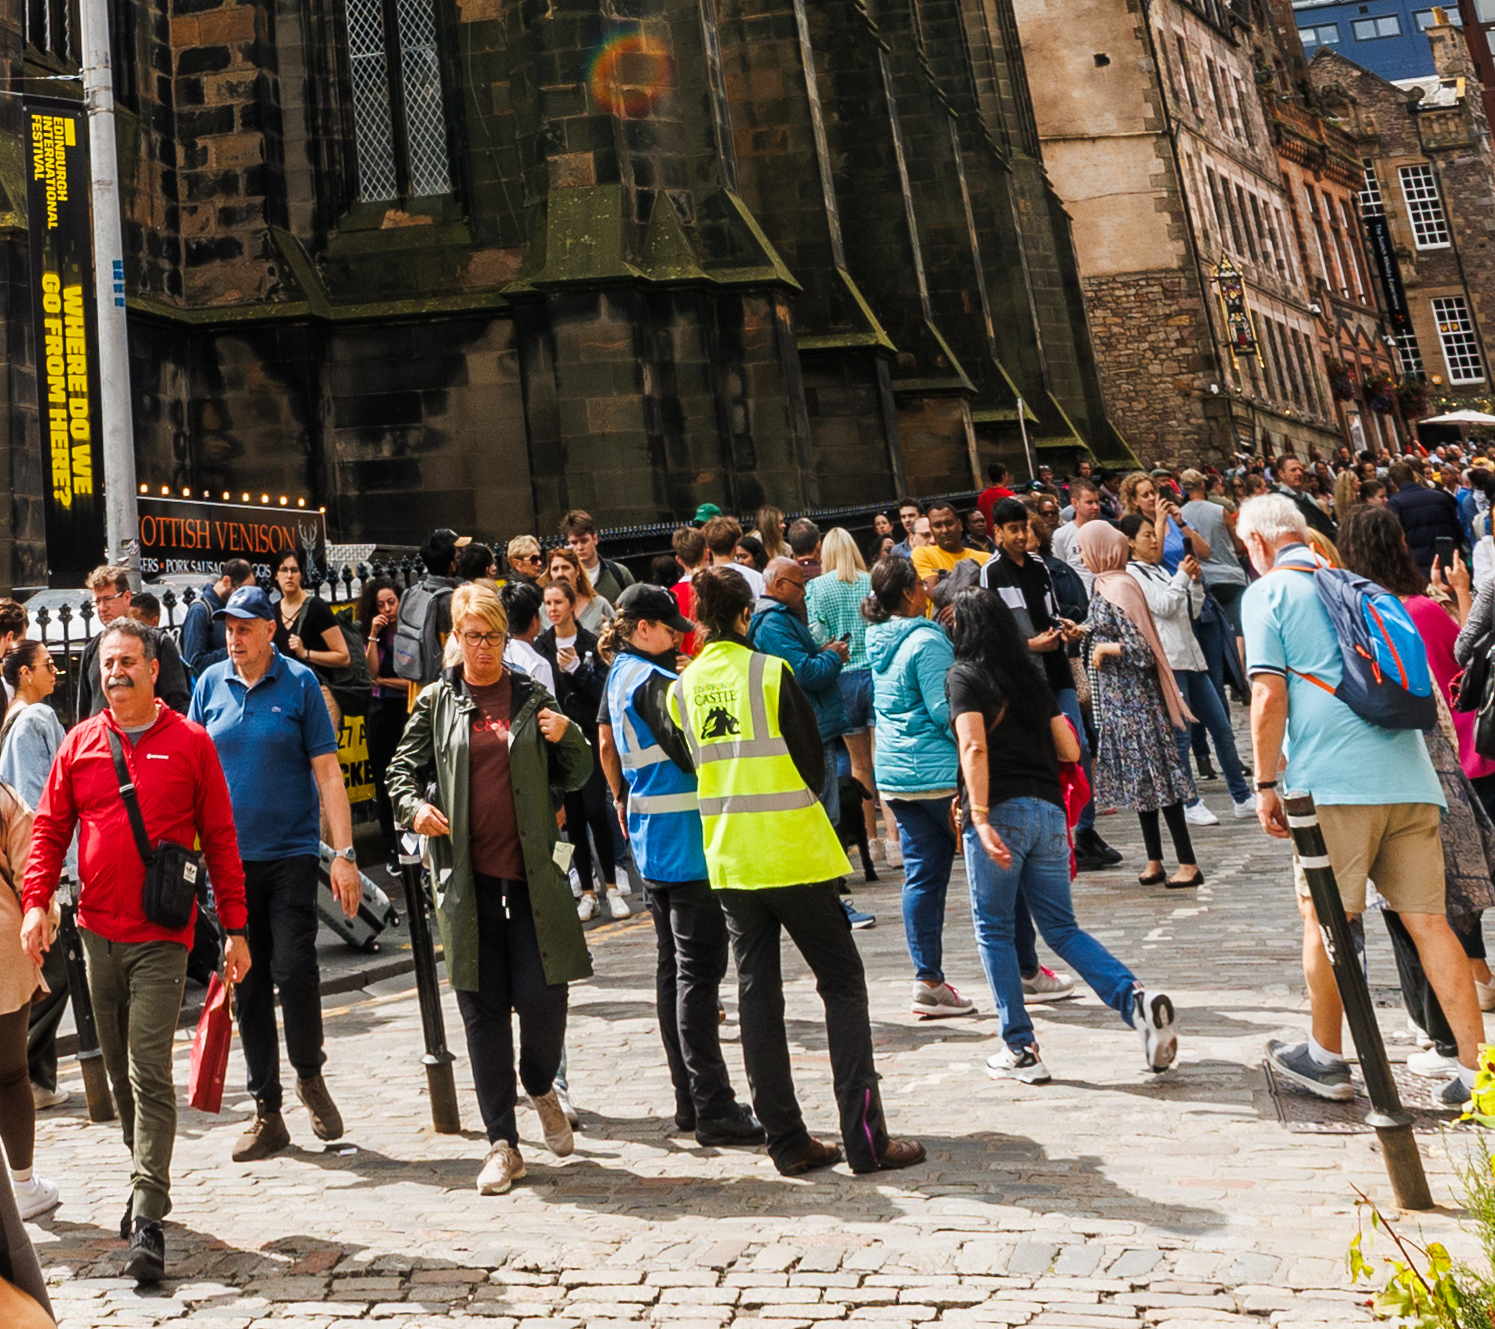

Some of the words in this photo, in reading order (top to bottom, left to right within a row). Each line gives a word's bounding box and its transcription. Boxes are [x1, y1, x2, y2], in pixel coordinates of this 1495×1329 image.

[31, 114, 45, 181] FESTIVAL
[42, 115, 59, 230] INTERNATIONAL
[53, 116, 68, 202] EDINBURGH
[41, 271, 62, 313] GO
[45, 315, 66, 401] FROM
[62, 285, 86, 392] WHERE
[69, 393, 89, 440] DO
[49, 403, 73, 510] HERE?
[72, 442, 93, 495] WE
[138, 515, 212, 549] OTTISH
[215, 521, 297, 553] VENISON
[165, 559, 190, 573] PORK
[694, 690, 738, 707] CASTLE
